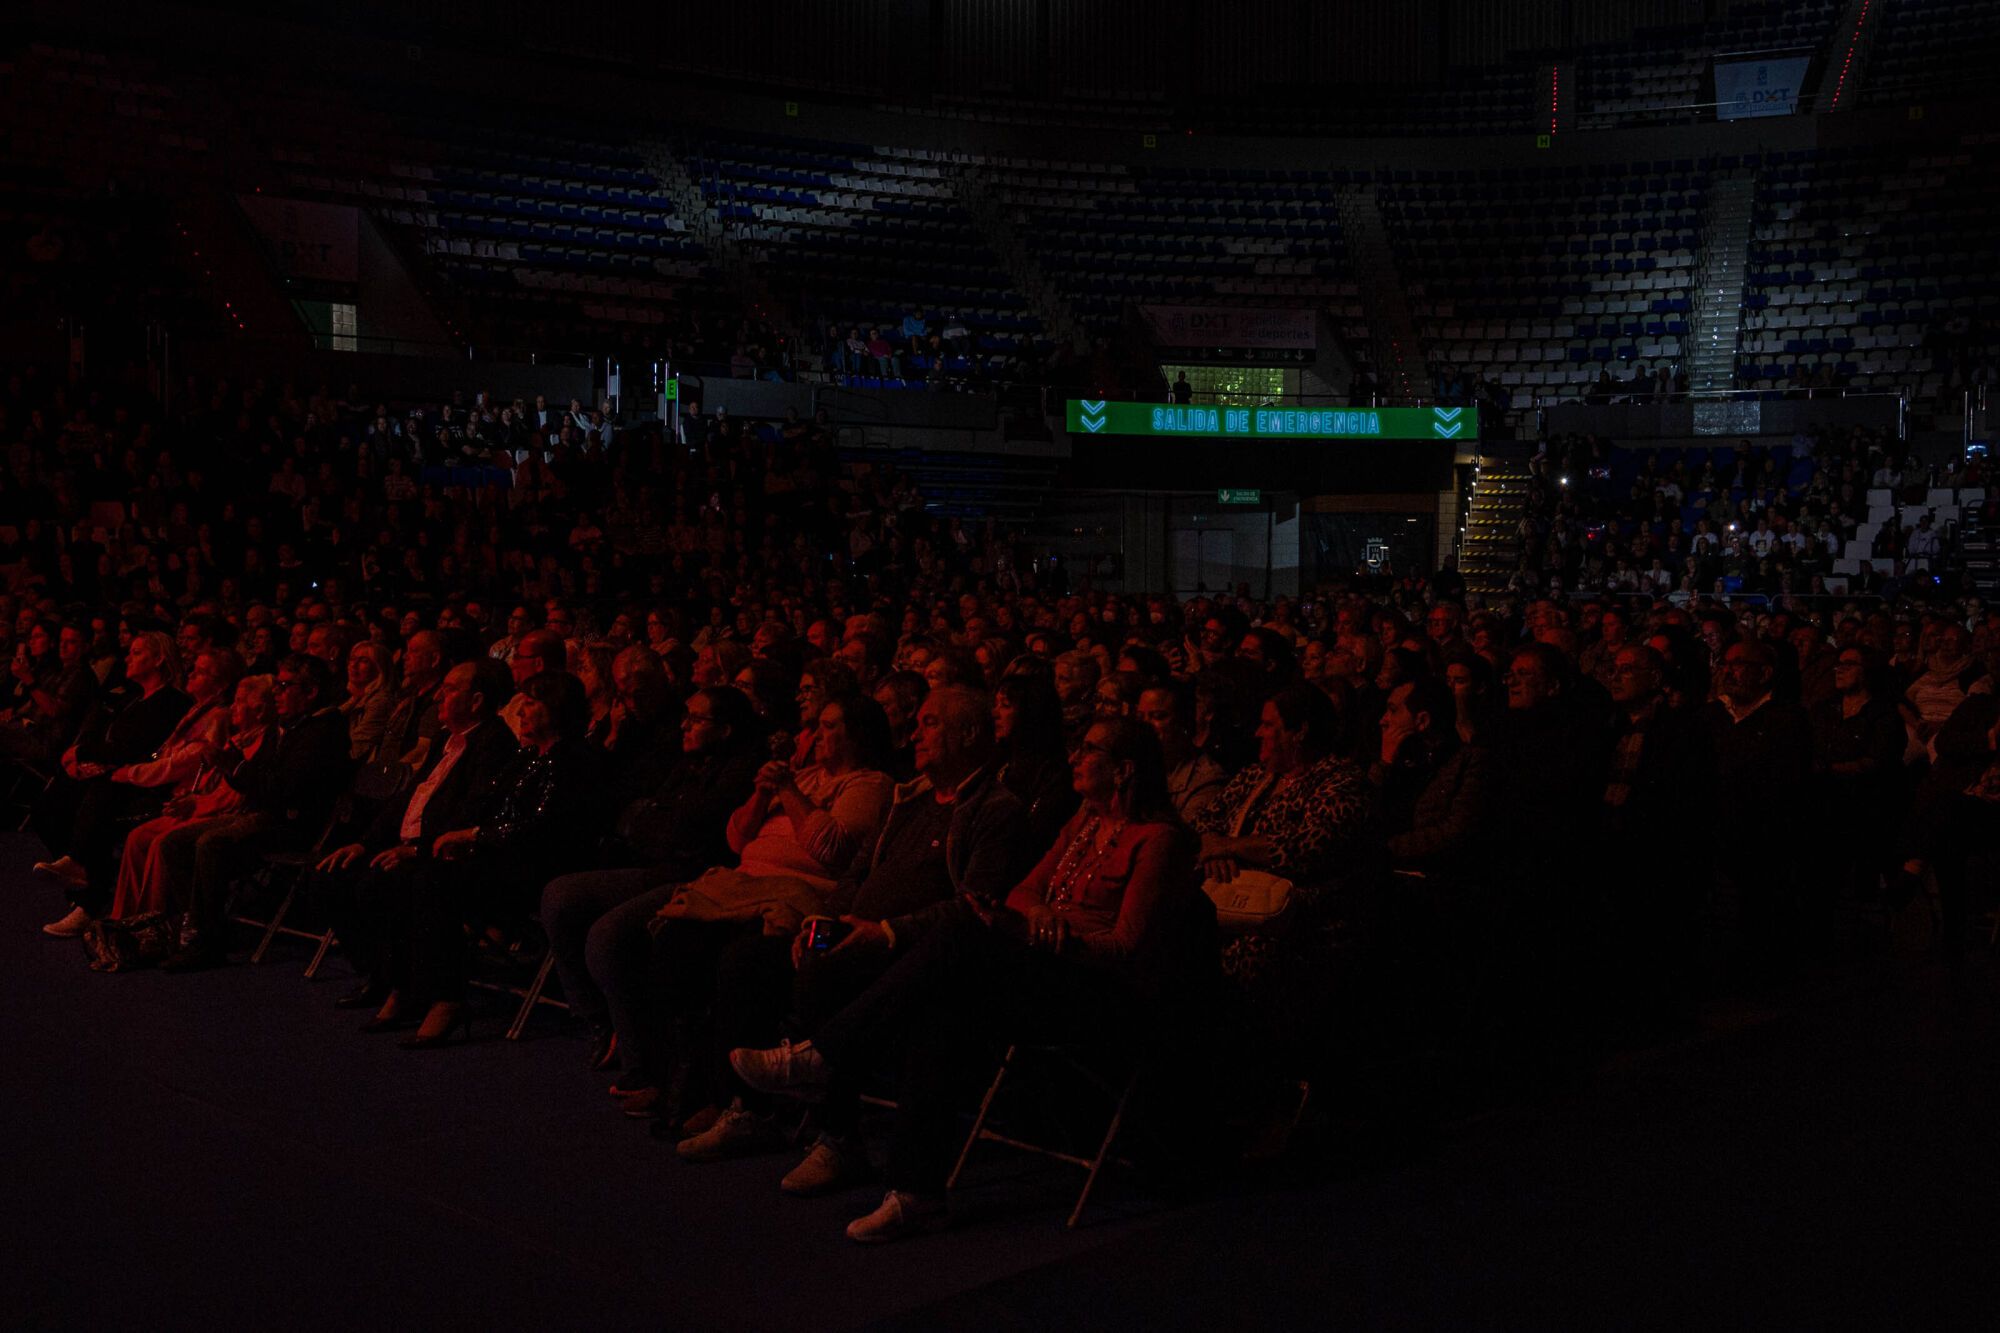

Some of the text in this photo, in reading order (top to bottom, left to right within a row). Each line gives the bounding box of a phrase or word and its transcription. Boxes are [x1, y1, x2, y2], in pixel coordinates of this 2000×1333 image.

[1752, 87, 1790, 104] DXT
[1190, 313, 1231, 328] DXT
[1152, 408, 1381, 435] SALIDA DE EMERGENCIA
